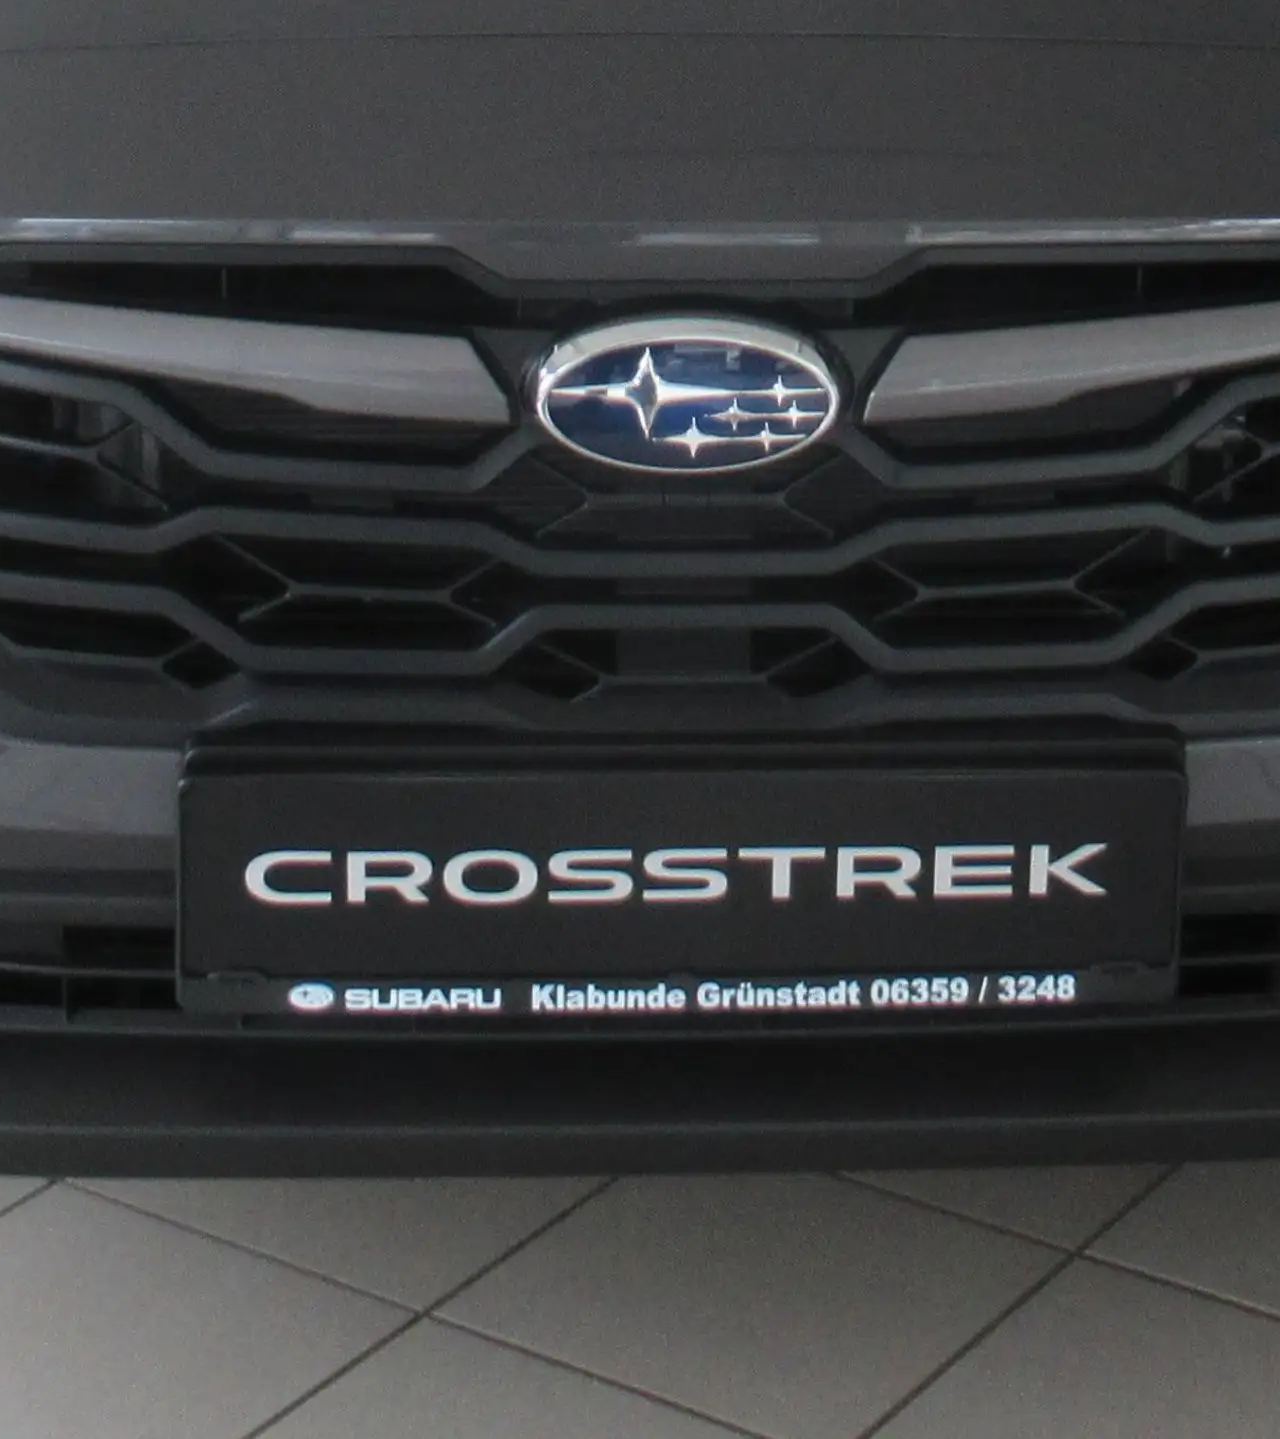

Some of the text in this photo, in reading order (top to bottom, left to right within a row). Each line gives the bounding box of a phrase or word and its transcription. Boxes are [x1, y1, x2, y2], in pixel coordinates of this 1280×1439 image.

[243, 843, 1108, 907] CROSSTREK
[344, 974, 1077, 1012] SUBARU Klabunde Grünstadt 06359 / 3248
